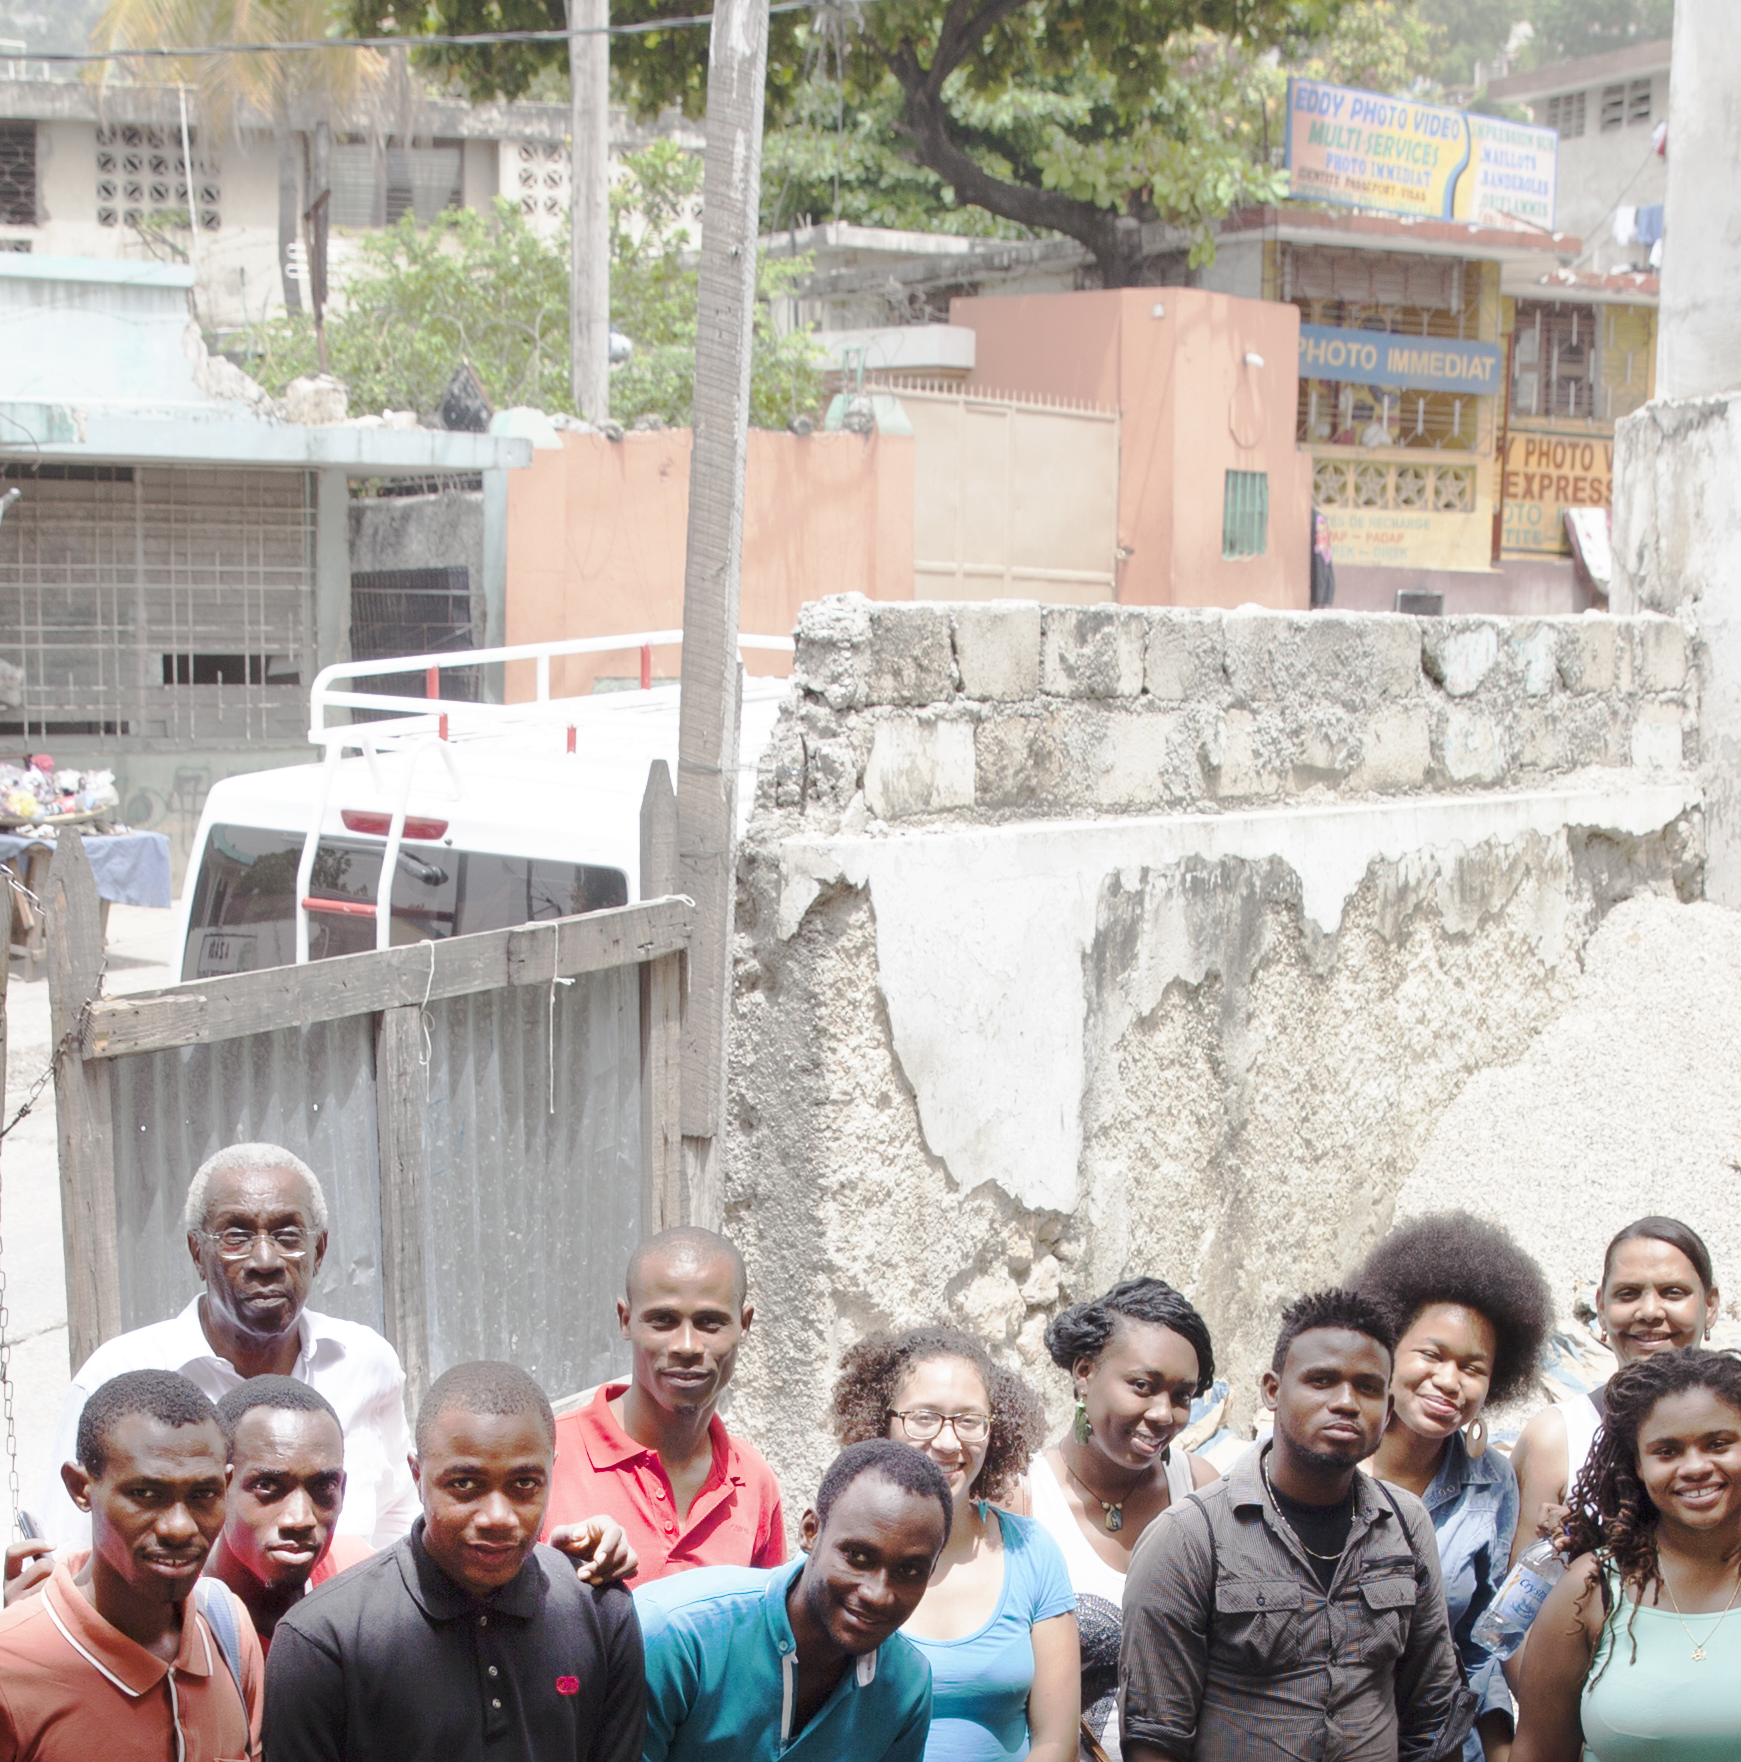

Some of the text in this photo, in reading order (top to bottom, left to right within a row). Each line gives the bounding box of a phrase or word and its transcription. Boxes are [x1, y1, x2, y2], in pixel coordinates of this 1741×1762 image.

[1295, 86, 1461, 141] EDDY PHOTO VIDEO
[1325, 151, 1432, 189] PHOTO IMMEDIAT
[1299, 336, 1496, 381] PHOTO IMMEDIAT
[1524, 438, 1595, 472] PHOTO
[1504, 470, 1613, 505] EXPRESS
